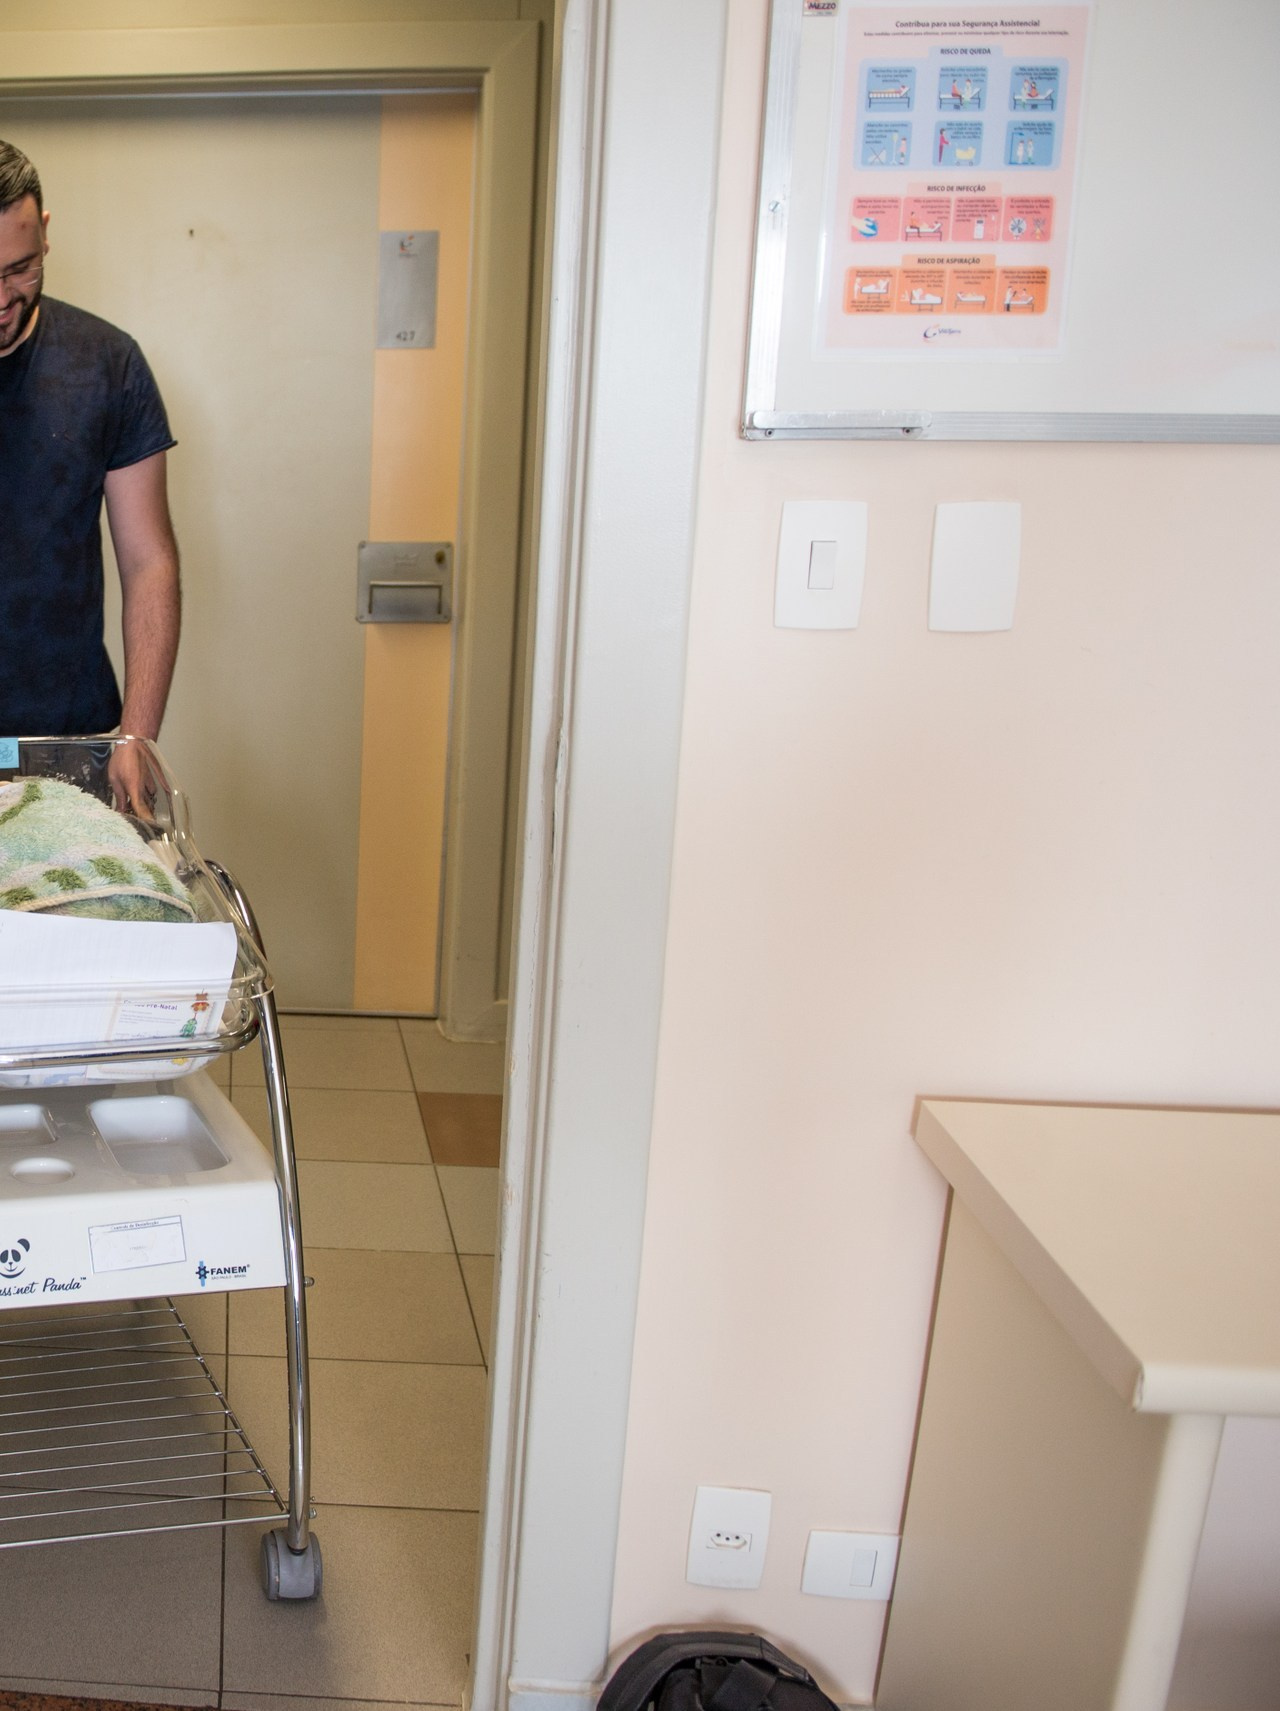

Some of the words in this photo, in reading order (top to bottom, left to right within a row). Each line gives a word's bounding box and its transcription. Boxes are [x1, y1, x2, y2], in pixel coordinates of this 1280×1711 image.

[895, 20, 929, 28] Contribua
[931, 21, 947, 29] para
[962, 20, 998, 29] Segurança
[1000, 19, 1040, 27] Assistencial
[969, 48, 991, 56] QUEDA
[956, 184, 986, 193] INFECÇÃO
[946, 256, 981, 265] ASPIRAÇÃO
